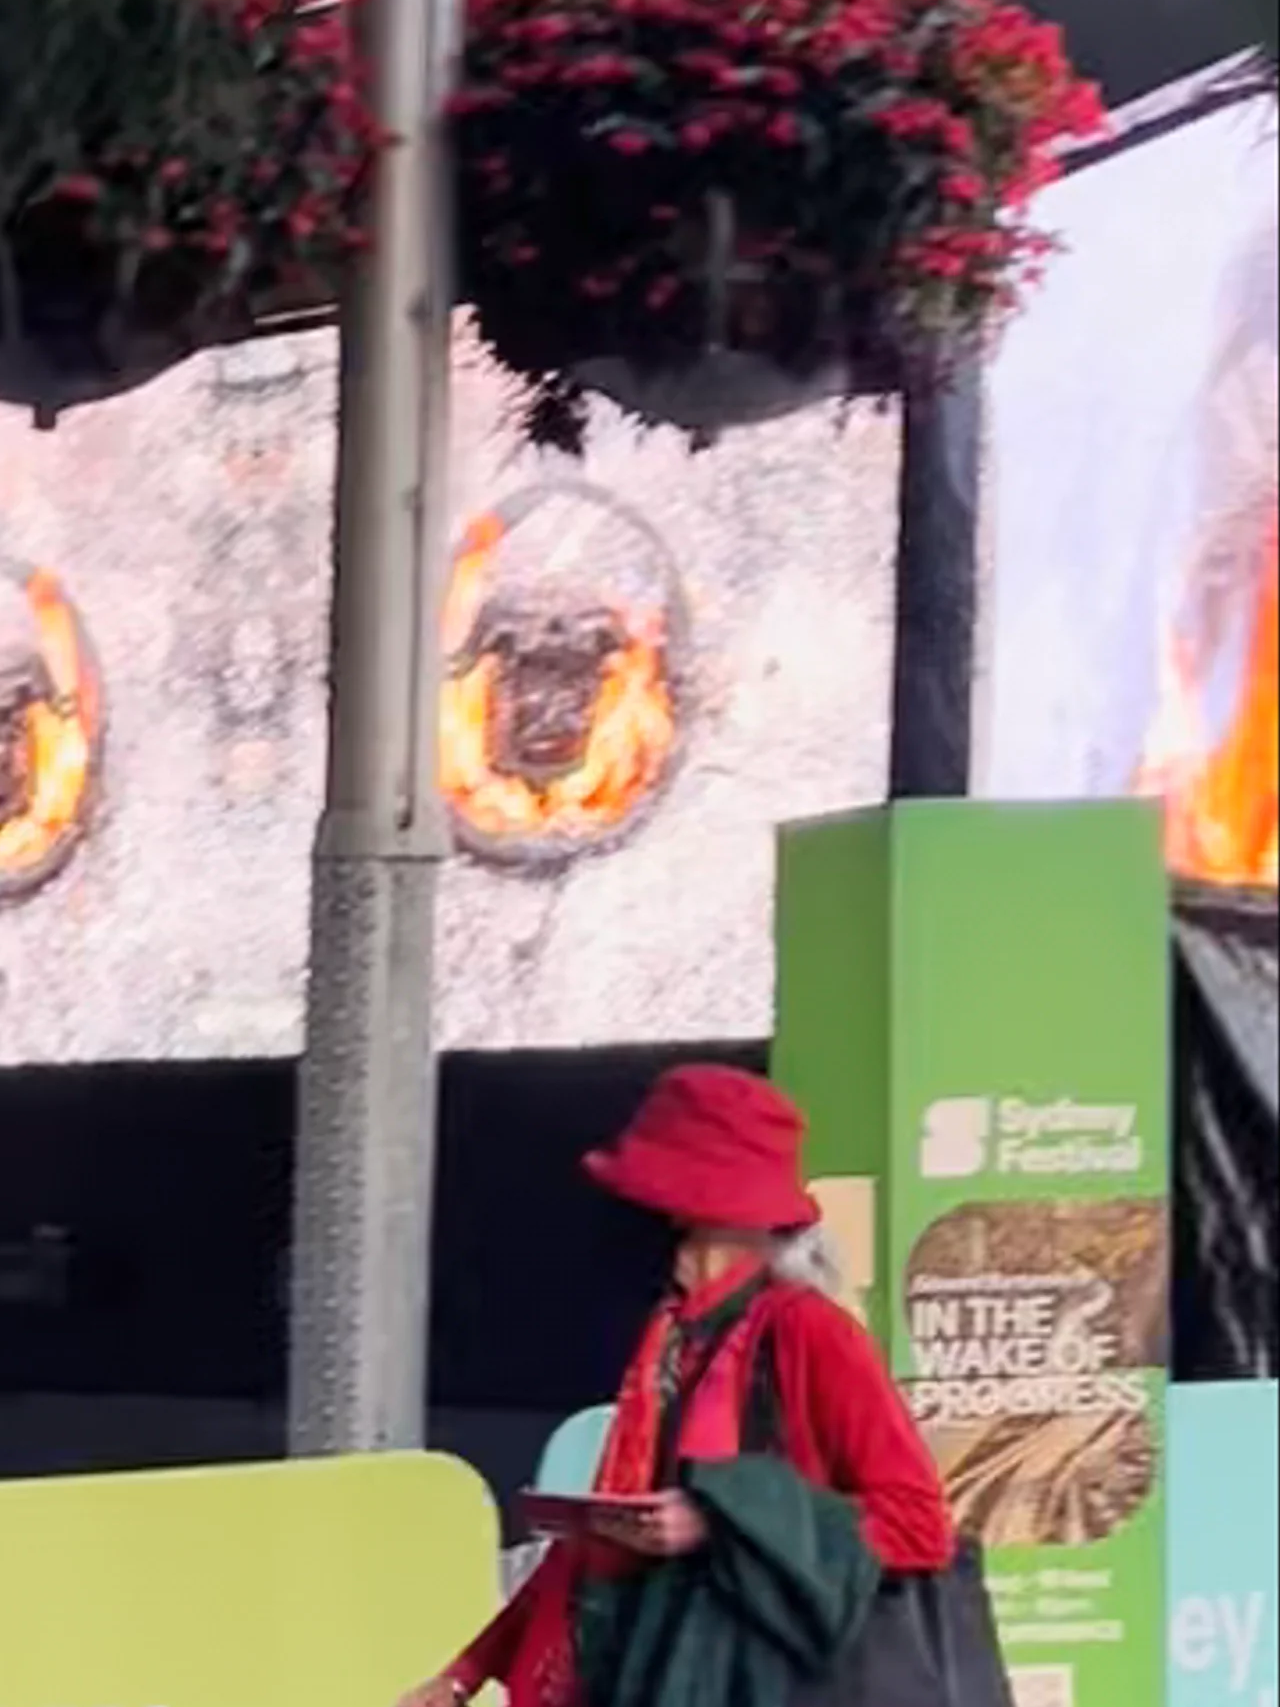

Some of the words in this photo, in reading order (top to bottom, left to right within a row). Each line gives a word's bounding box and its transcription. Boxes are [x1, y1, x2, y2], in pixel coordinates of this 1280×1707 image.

[997, 1136, 1144, 1174] Festival
[911, 1299, 960, 1337] IN
[964, 1295, 1057, 1335] THE
[910, 1335, 1047, 1378] WAKE
[1049, 1329, 1121, 1375] OF
[911, 1371, 1149, 1418] PROGRESS
